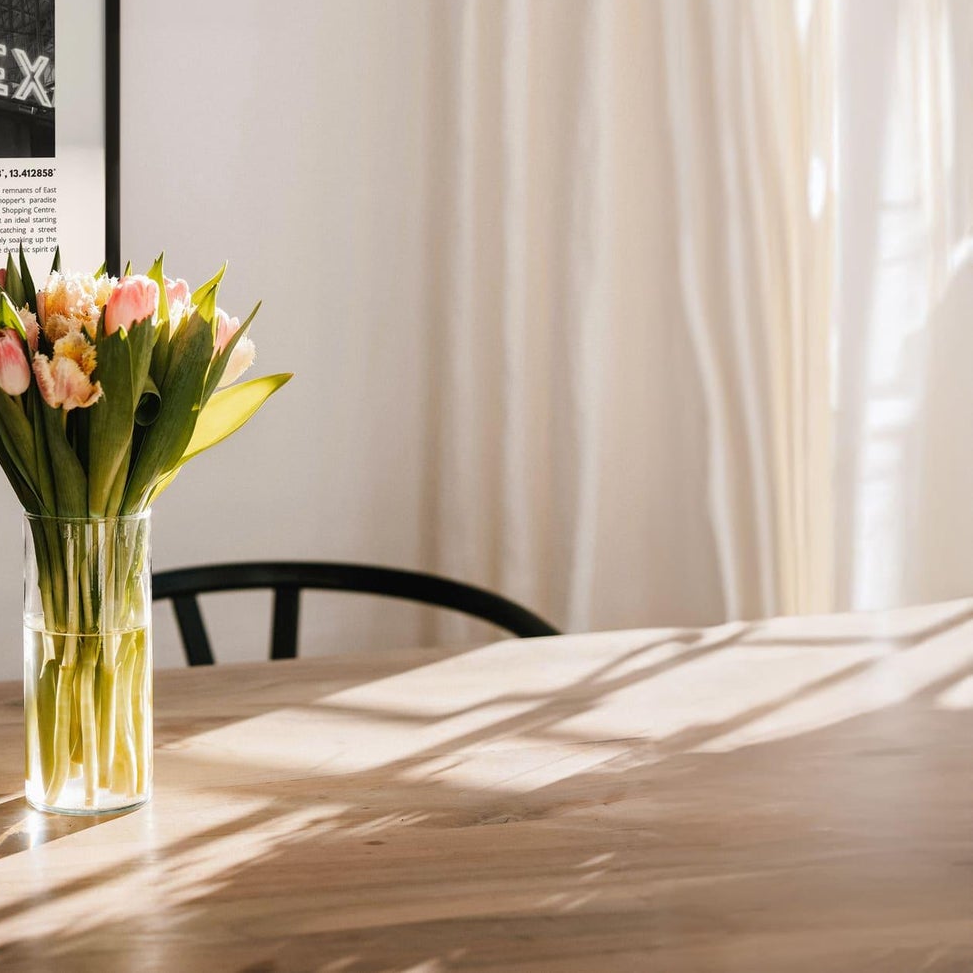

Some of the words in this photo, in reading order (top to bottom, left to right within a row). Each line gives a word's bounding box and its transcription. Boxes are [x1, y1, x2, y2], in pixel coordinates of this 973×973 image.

[29, 197, 57, 205] paradise
[2, 207, 32, 215] Shopping
[33, 216, 57, 224] starting
[0, 227, 27, 235] catching
[32, 246, 48, 254] spirit
